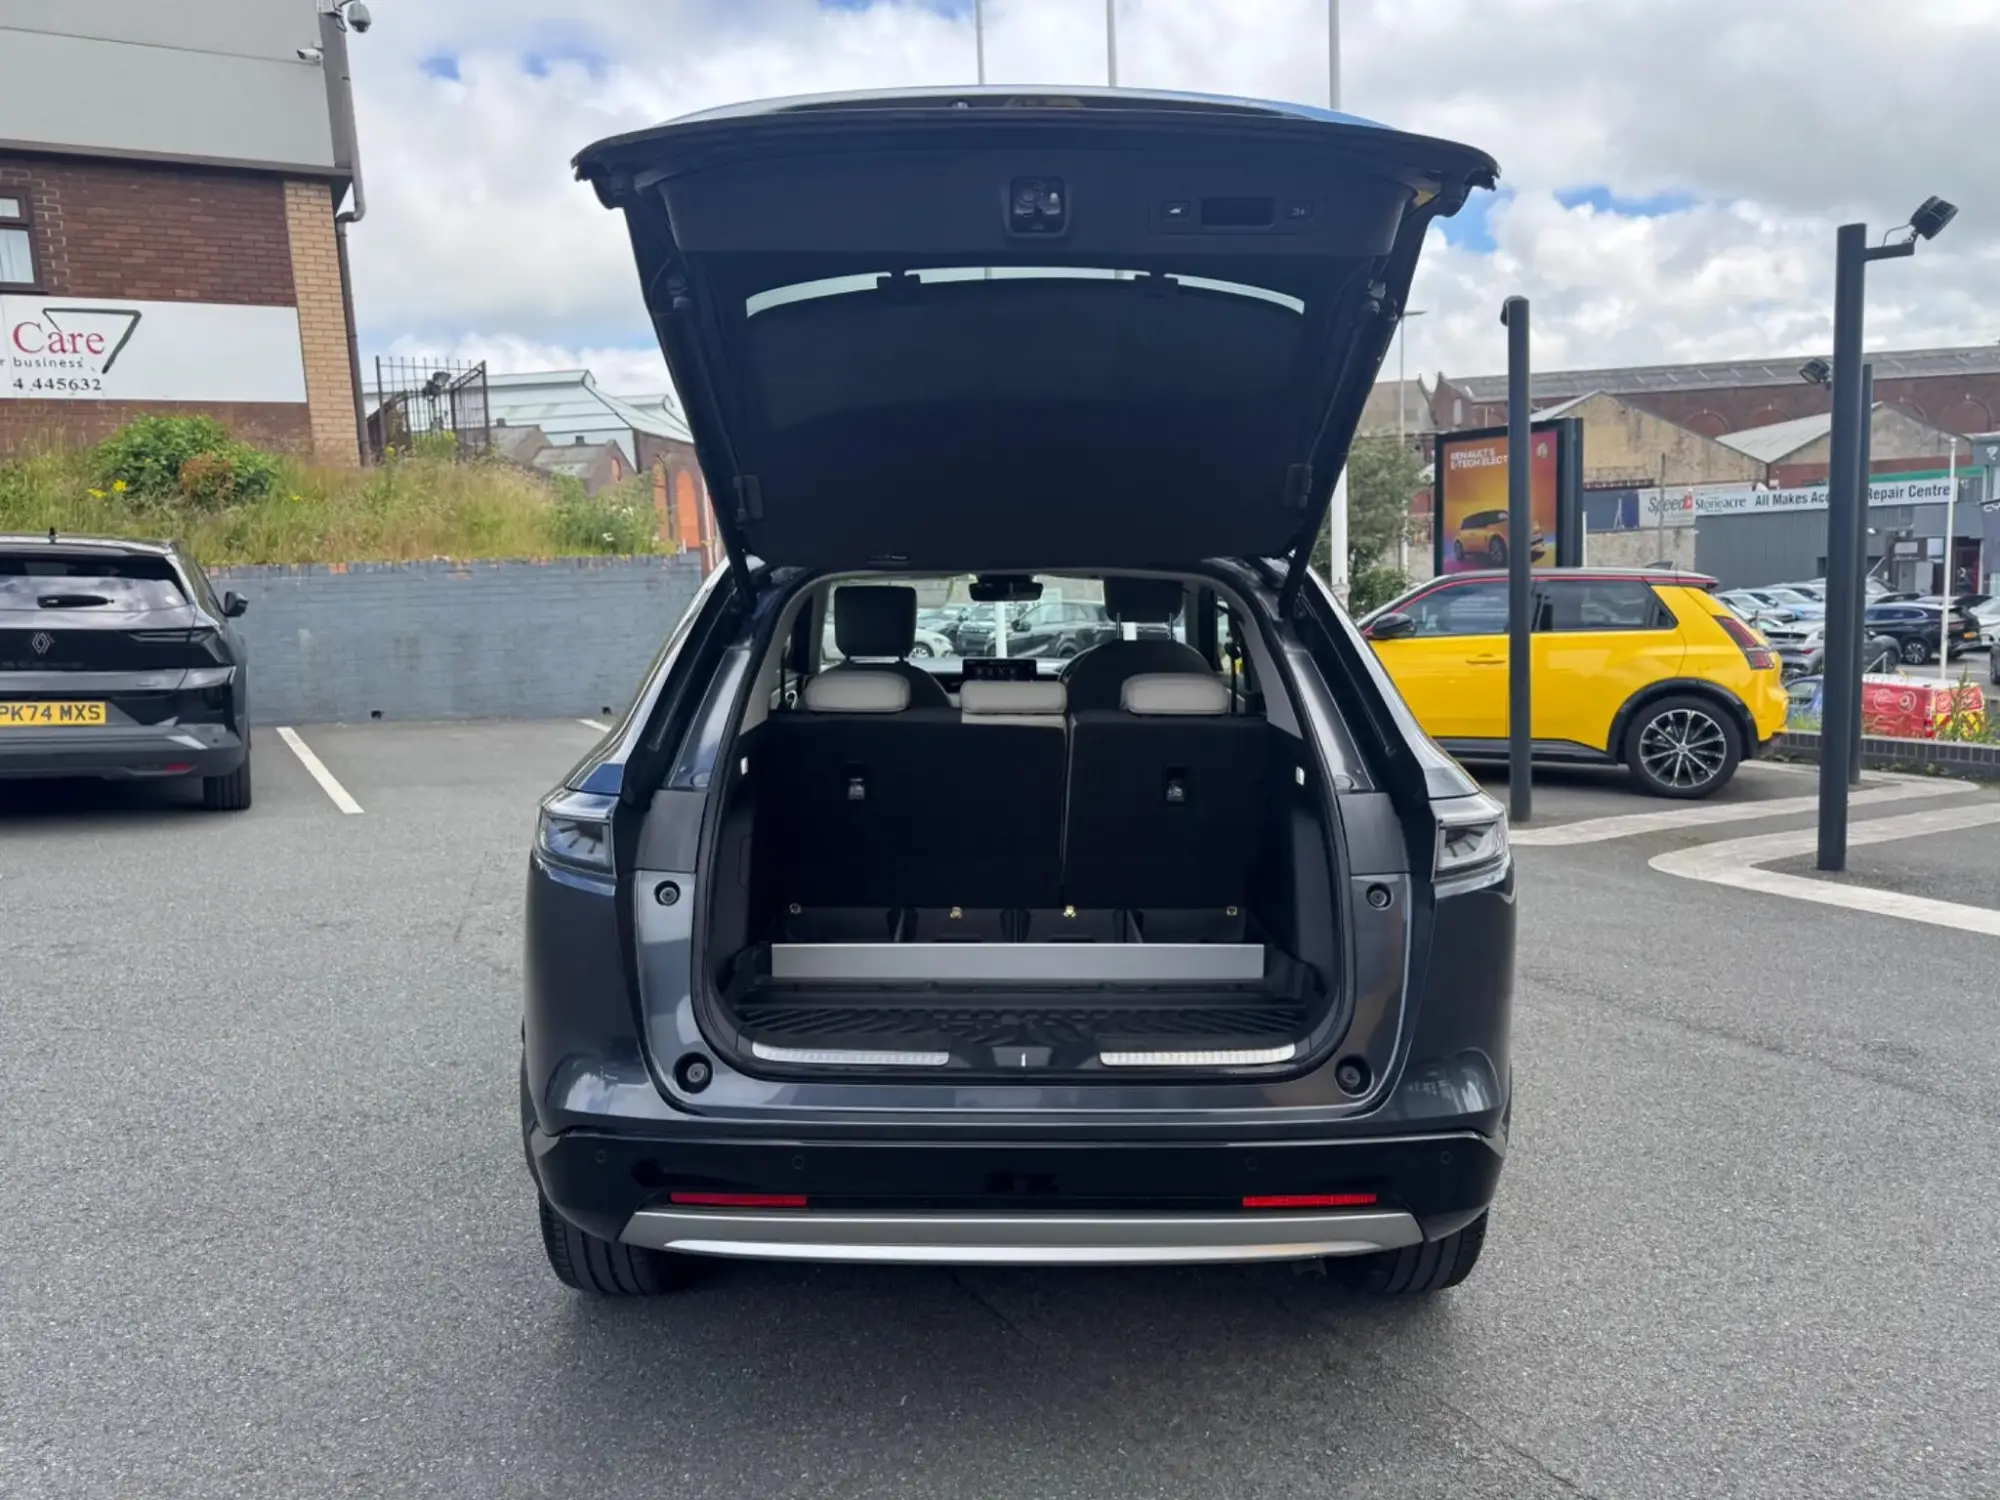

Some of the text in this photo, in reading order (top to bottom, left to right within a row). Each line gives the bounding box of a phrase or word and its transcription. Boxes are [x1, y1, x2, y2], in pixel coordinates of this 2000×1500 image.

[12, 321, 106, 355] Care
[13, 356, 84, 368] business
[32, 377, 102, 391] 445632
[1481, 454, 1509, 467] ELECT
[1754, 493, 1770, 507] All
[1772, 492, 1808, 506] Makes
[1867, 485, 1905, 502] Repair
[1907, 483, 1951, 498] Centre
[59, 704, 101, 721] MXS
